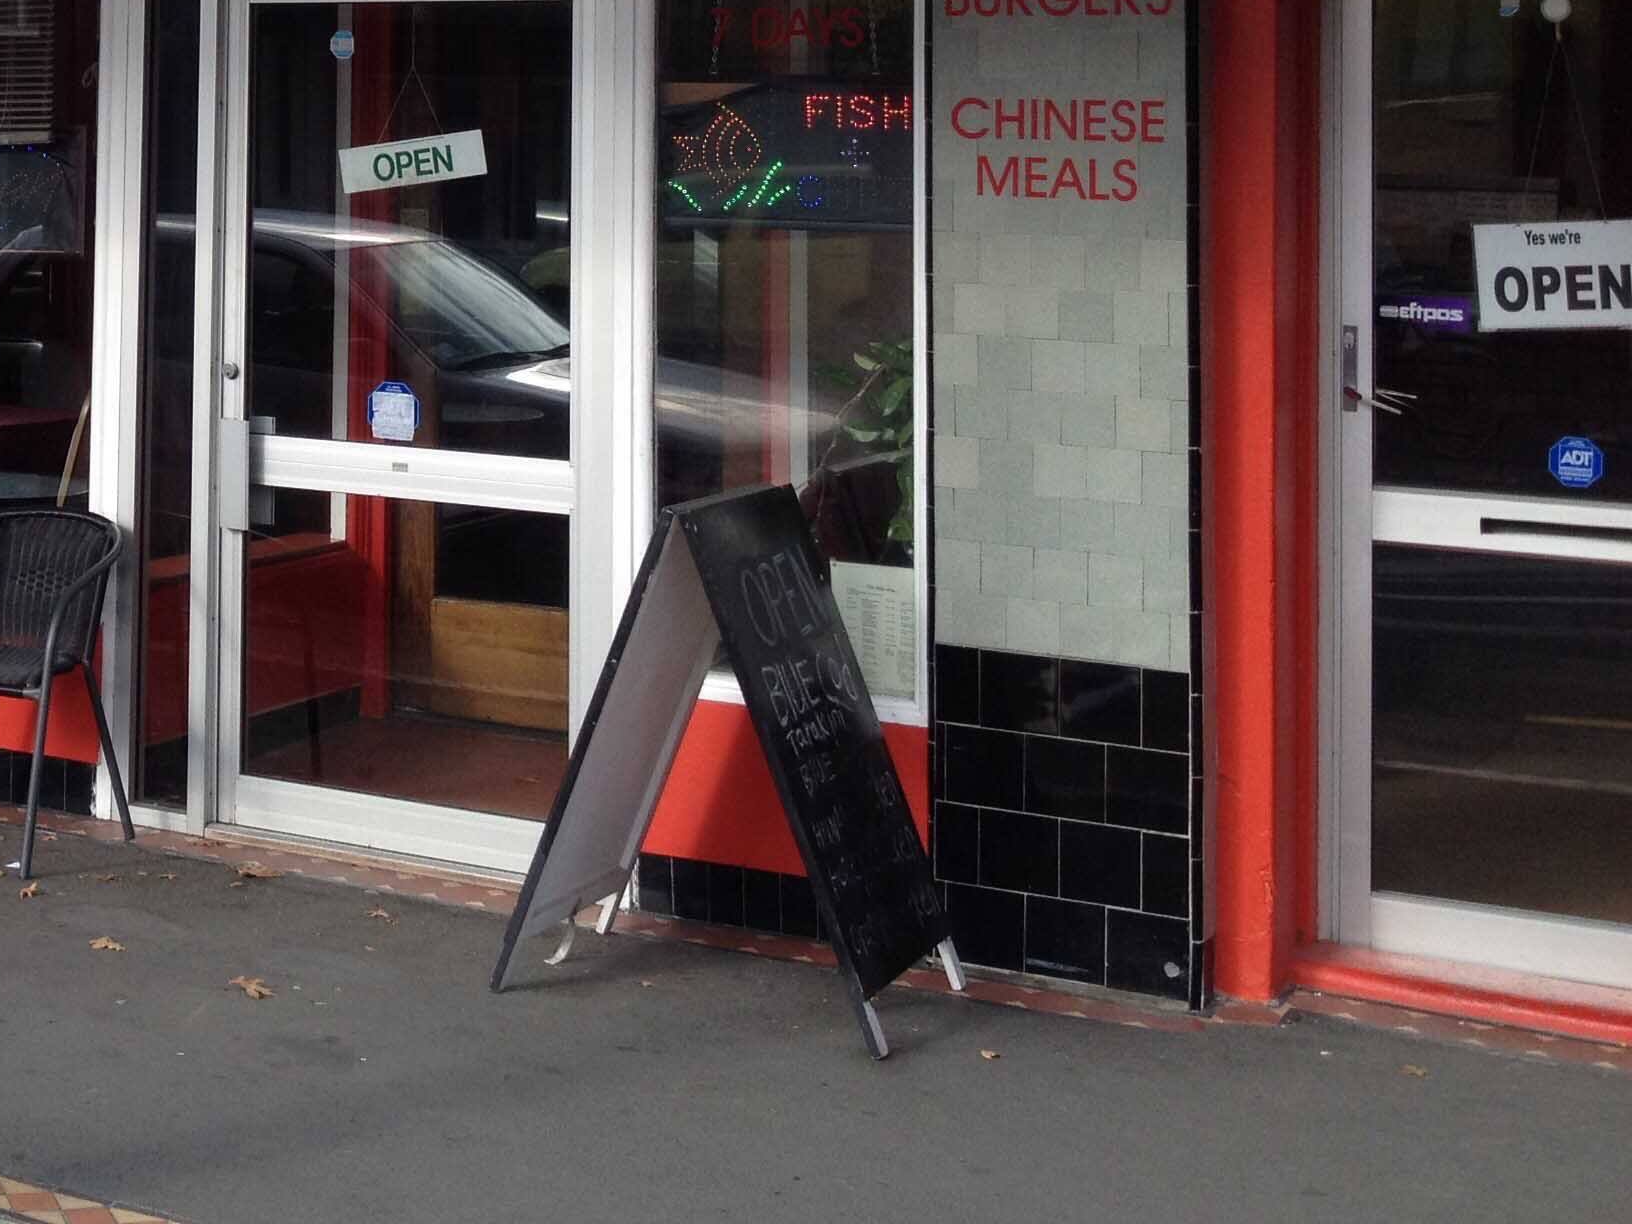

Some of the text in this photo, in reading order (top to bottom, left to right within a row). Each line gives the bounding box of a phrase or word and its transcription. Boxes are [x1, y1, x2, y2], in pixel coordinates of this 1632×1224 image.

[751, 7, 866, 48] DAYS
[804, 94, 912, 130] FISH
[950, 96, 1167, 144] CHINESE
[372, 144, 454, 182] OPEN
[975, 154, 1139, 202] MEALS
[1523, 229, 1582, 246] Yes we're
[1493, 263, 1632, 313] OPEN
[1399, 301, 1464, 323] eftpos
[1560, 449, 1593, 467] ADT
[741, 544, 832, 646] OPEN
